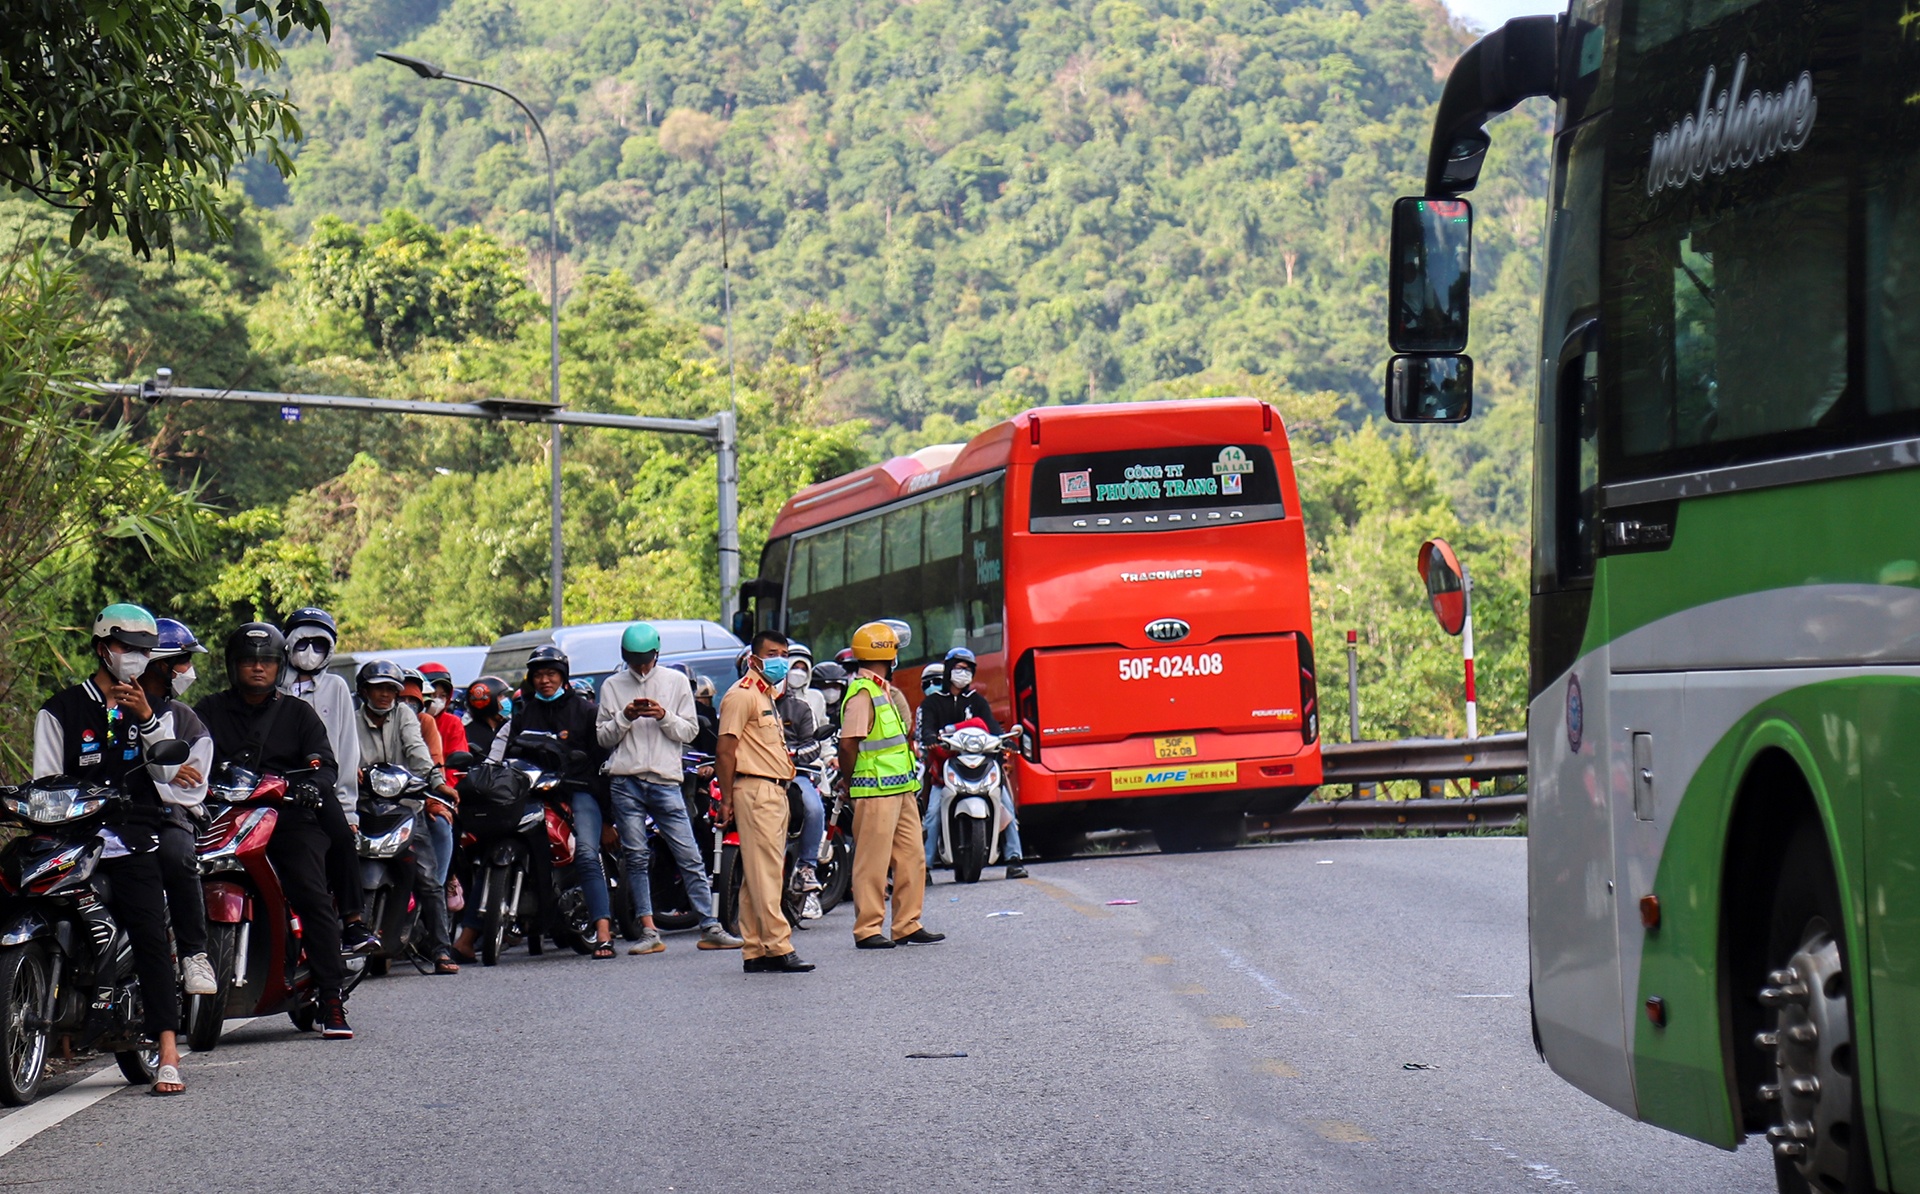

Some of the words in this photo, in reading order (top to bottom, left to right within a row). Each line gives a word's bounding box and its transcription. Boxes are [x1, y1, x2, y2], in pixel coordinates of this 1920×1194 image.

[1225, 450, 1241, 461] 14
[1124, 464, 1163, 480] CÔNG
[1164, 464, 1185, 478] TY
[1163, 477, 1218, 498] TRANG
[1152, 623, 1184, 638] KIA
[870, 641, 894, 649] CSGT
[1119, 653, 1223, 681] 50F-024.08
[1165, 738, 1182, 747] 50F
[1160, 747, 1192, 757] 024.08
[1130, 775, 1143, 783] LED
[1145, 770, 1187, 783] MPE
